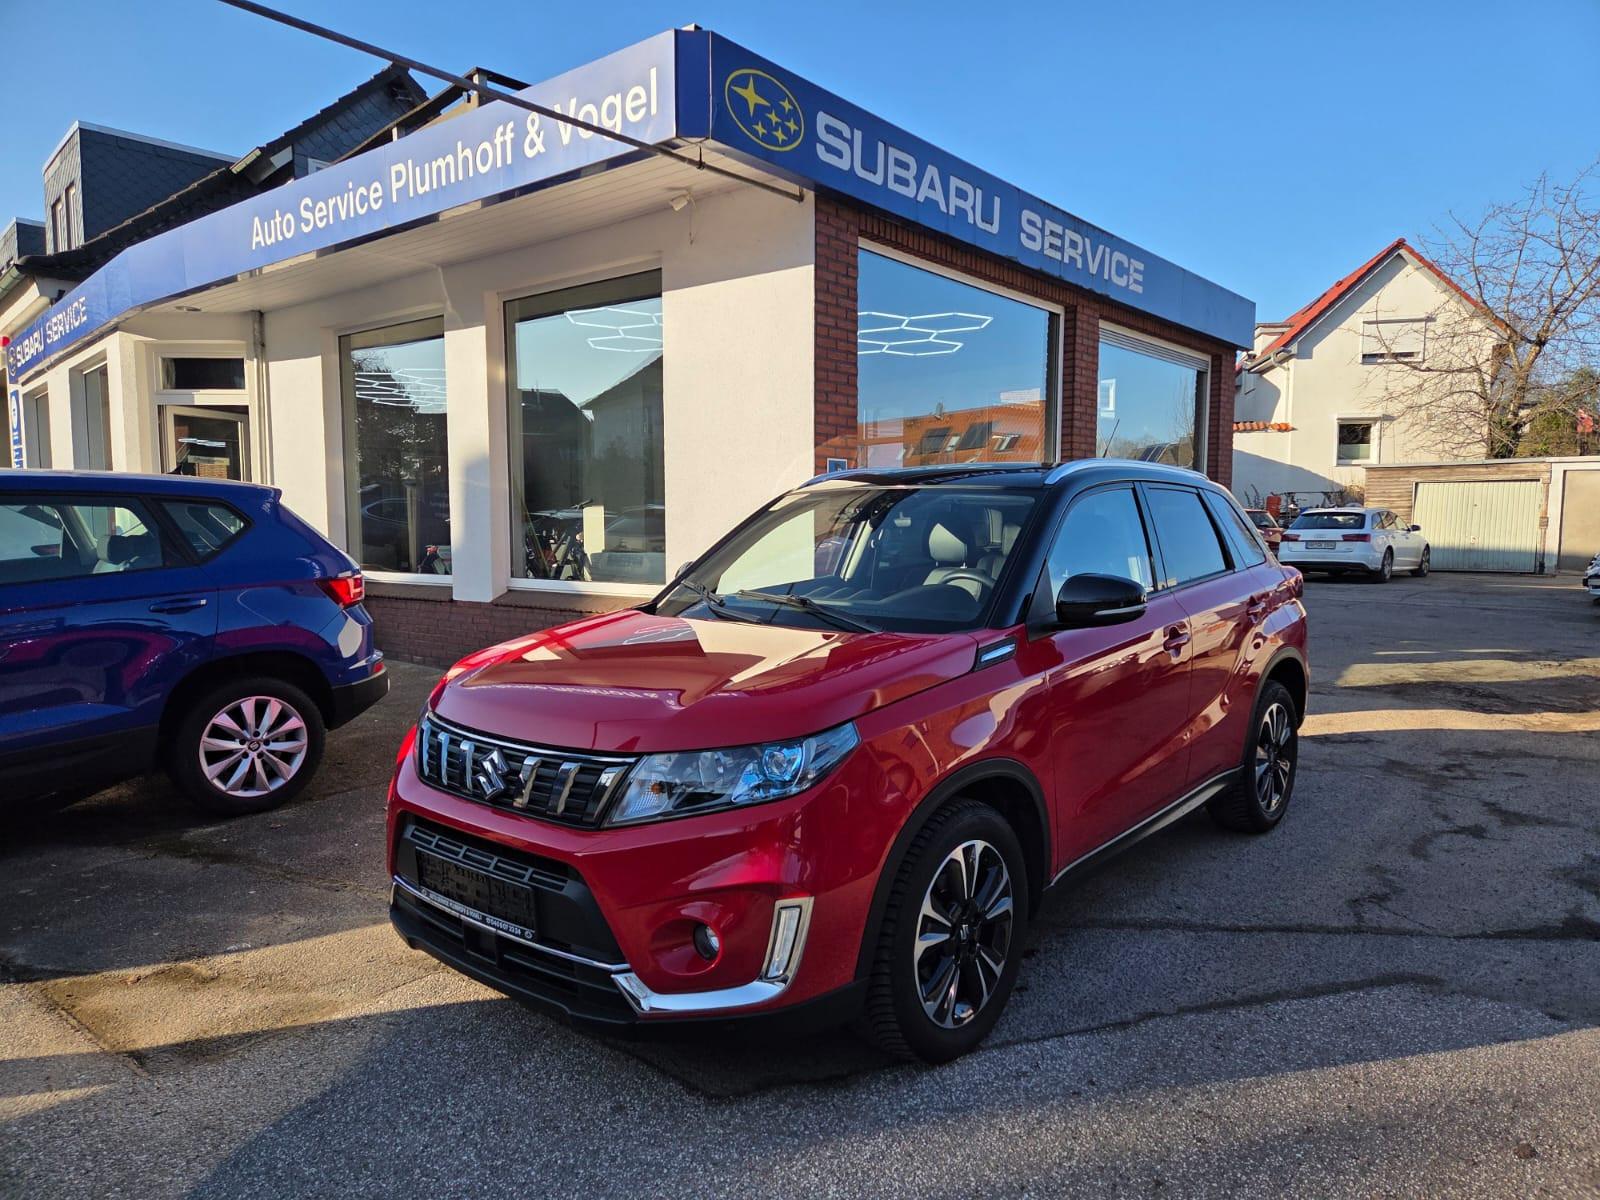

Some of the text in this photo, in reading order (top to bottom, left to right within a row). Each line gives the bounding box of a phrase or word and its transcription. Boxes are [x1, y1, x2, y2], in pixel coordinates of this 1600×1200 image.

[252, 66, 658, 250] Auto Service Plumhoff & Vogel
[815, 111, 1145, 294] SUBARU SERVICE
[16, 296, 88, 368] SUBARU SERVICE
